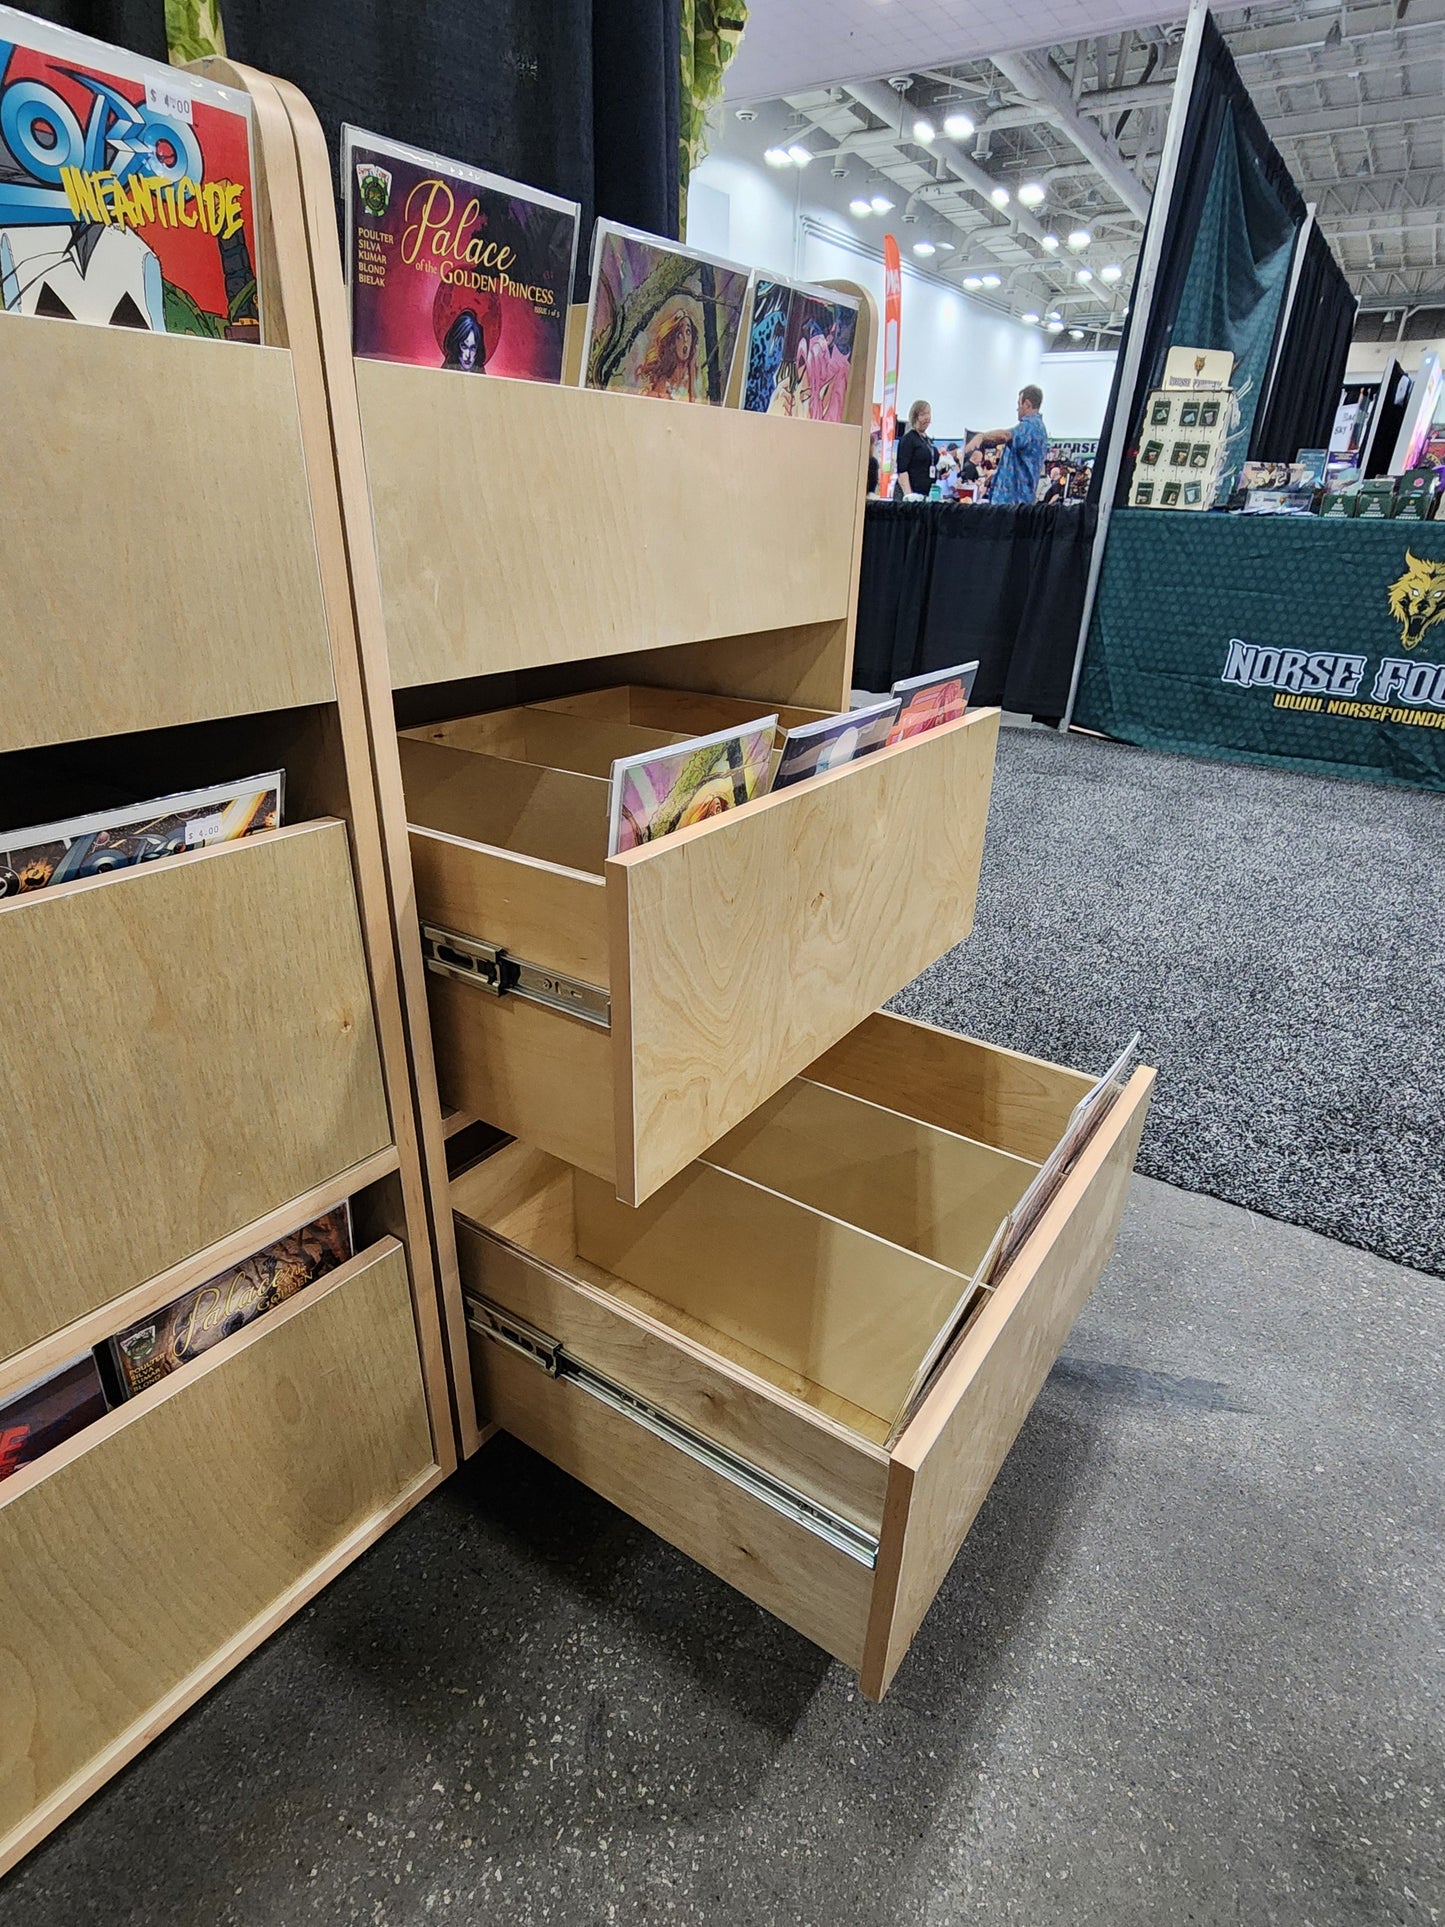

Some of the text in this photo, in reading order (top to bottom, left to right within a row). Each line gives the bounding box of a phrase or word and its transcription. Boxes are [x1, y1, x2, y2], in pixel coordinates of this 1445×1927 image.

[164, 94, 190, 114] 4.00
[59, 165, 245, 240] INFANTICIDE
[401, 179, 517, 271] Palace
[358, 226, 394, 245] POULTER
[358, 239, 381, 253] SILVA
[358, 250, 387, 265] KUMAR
[358, 262, 386, 276] BLOND
[358, 273, 386, 288] BIELAK
[415, 259, 555, 305] of the GOLDEN PRINCESS
[1221, 639, 1367, 698] NORSE
[199, 825, 219, 837] 4.00
[172, 1269, 285, 1357] Palace
